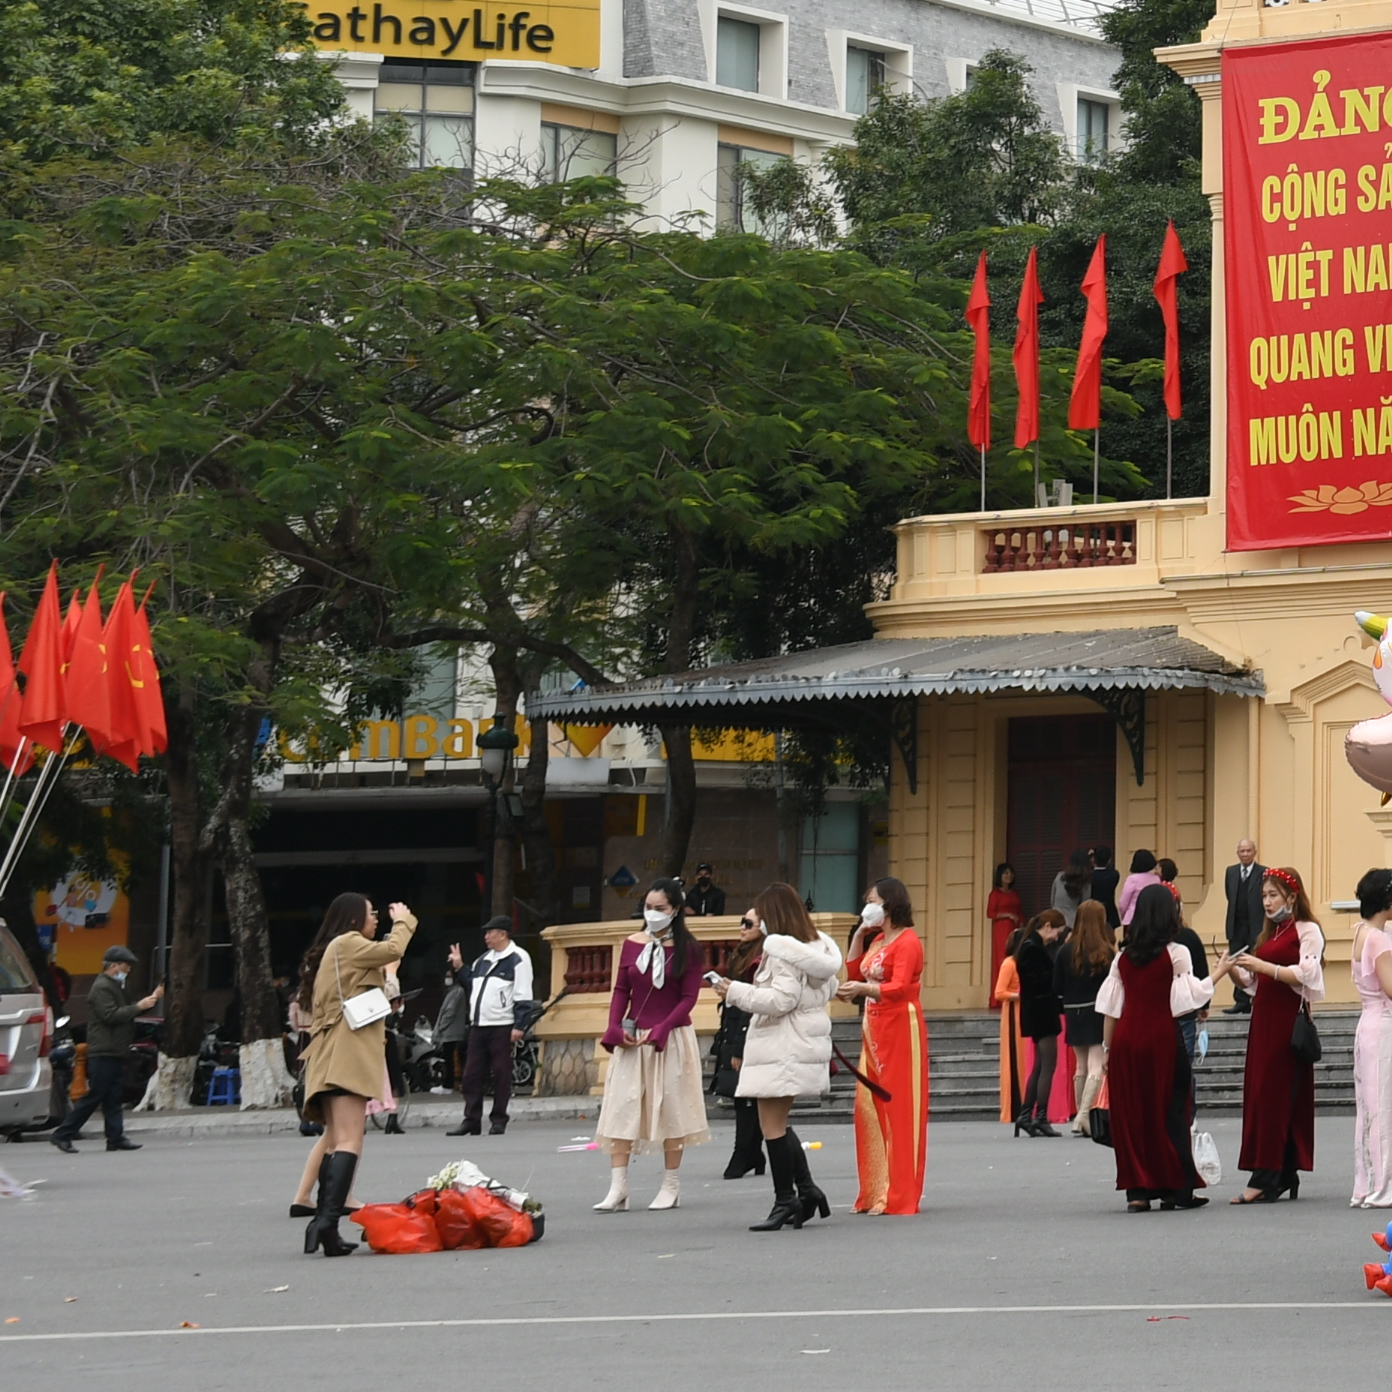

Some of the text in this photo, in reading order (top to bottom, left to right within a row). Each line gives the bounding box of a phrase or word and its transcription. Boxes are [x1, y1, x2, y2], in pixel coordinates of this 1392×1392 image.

[289, 2, 555, 55] athayLife
[1261, 164, 1347, 231] CỘNG
[1267, 241, 1333, 310] VIỆT
[1249, 327, 1354, 390] QUANG
[1249, 404, 1343, 466] MUÔN
